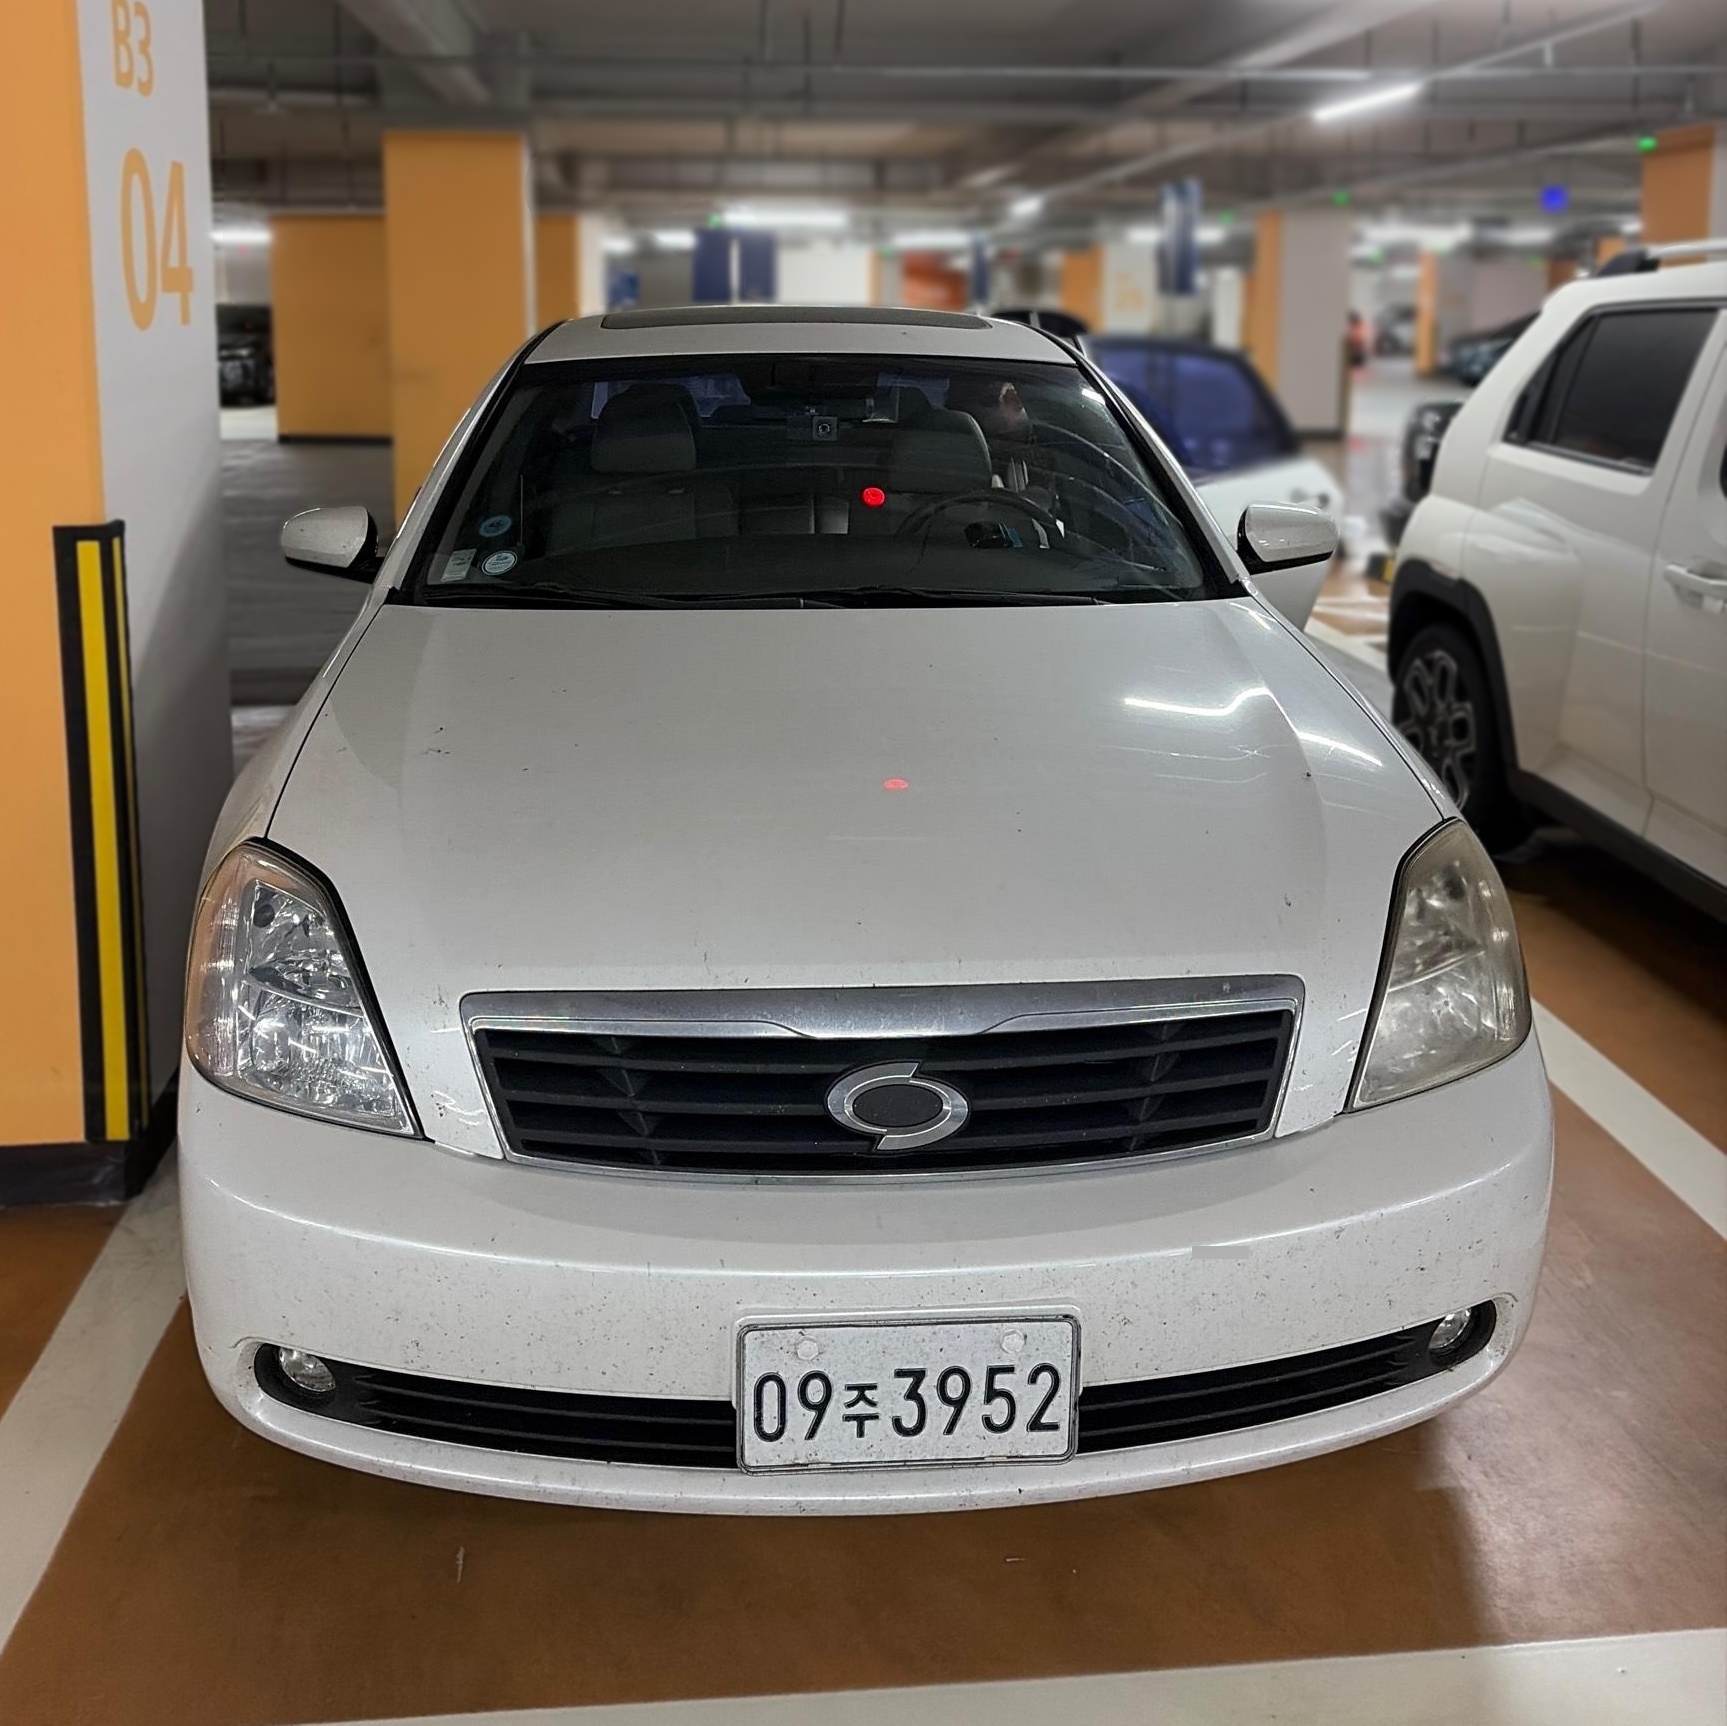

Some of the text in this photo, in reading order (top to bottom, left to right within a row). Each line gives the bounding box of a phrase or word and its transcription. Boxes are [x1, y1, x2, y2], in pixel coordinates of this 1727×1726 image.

[111, 0, 154, 97] B3
[121, 148, 193, 331] 04
[753, 1362, 1061, 1442] 09주3952
